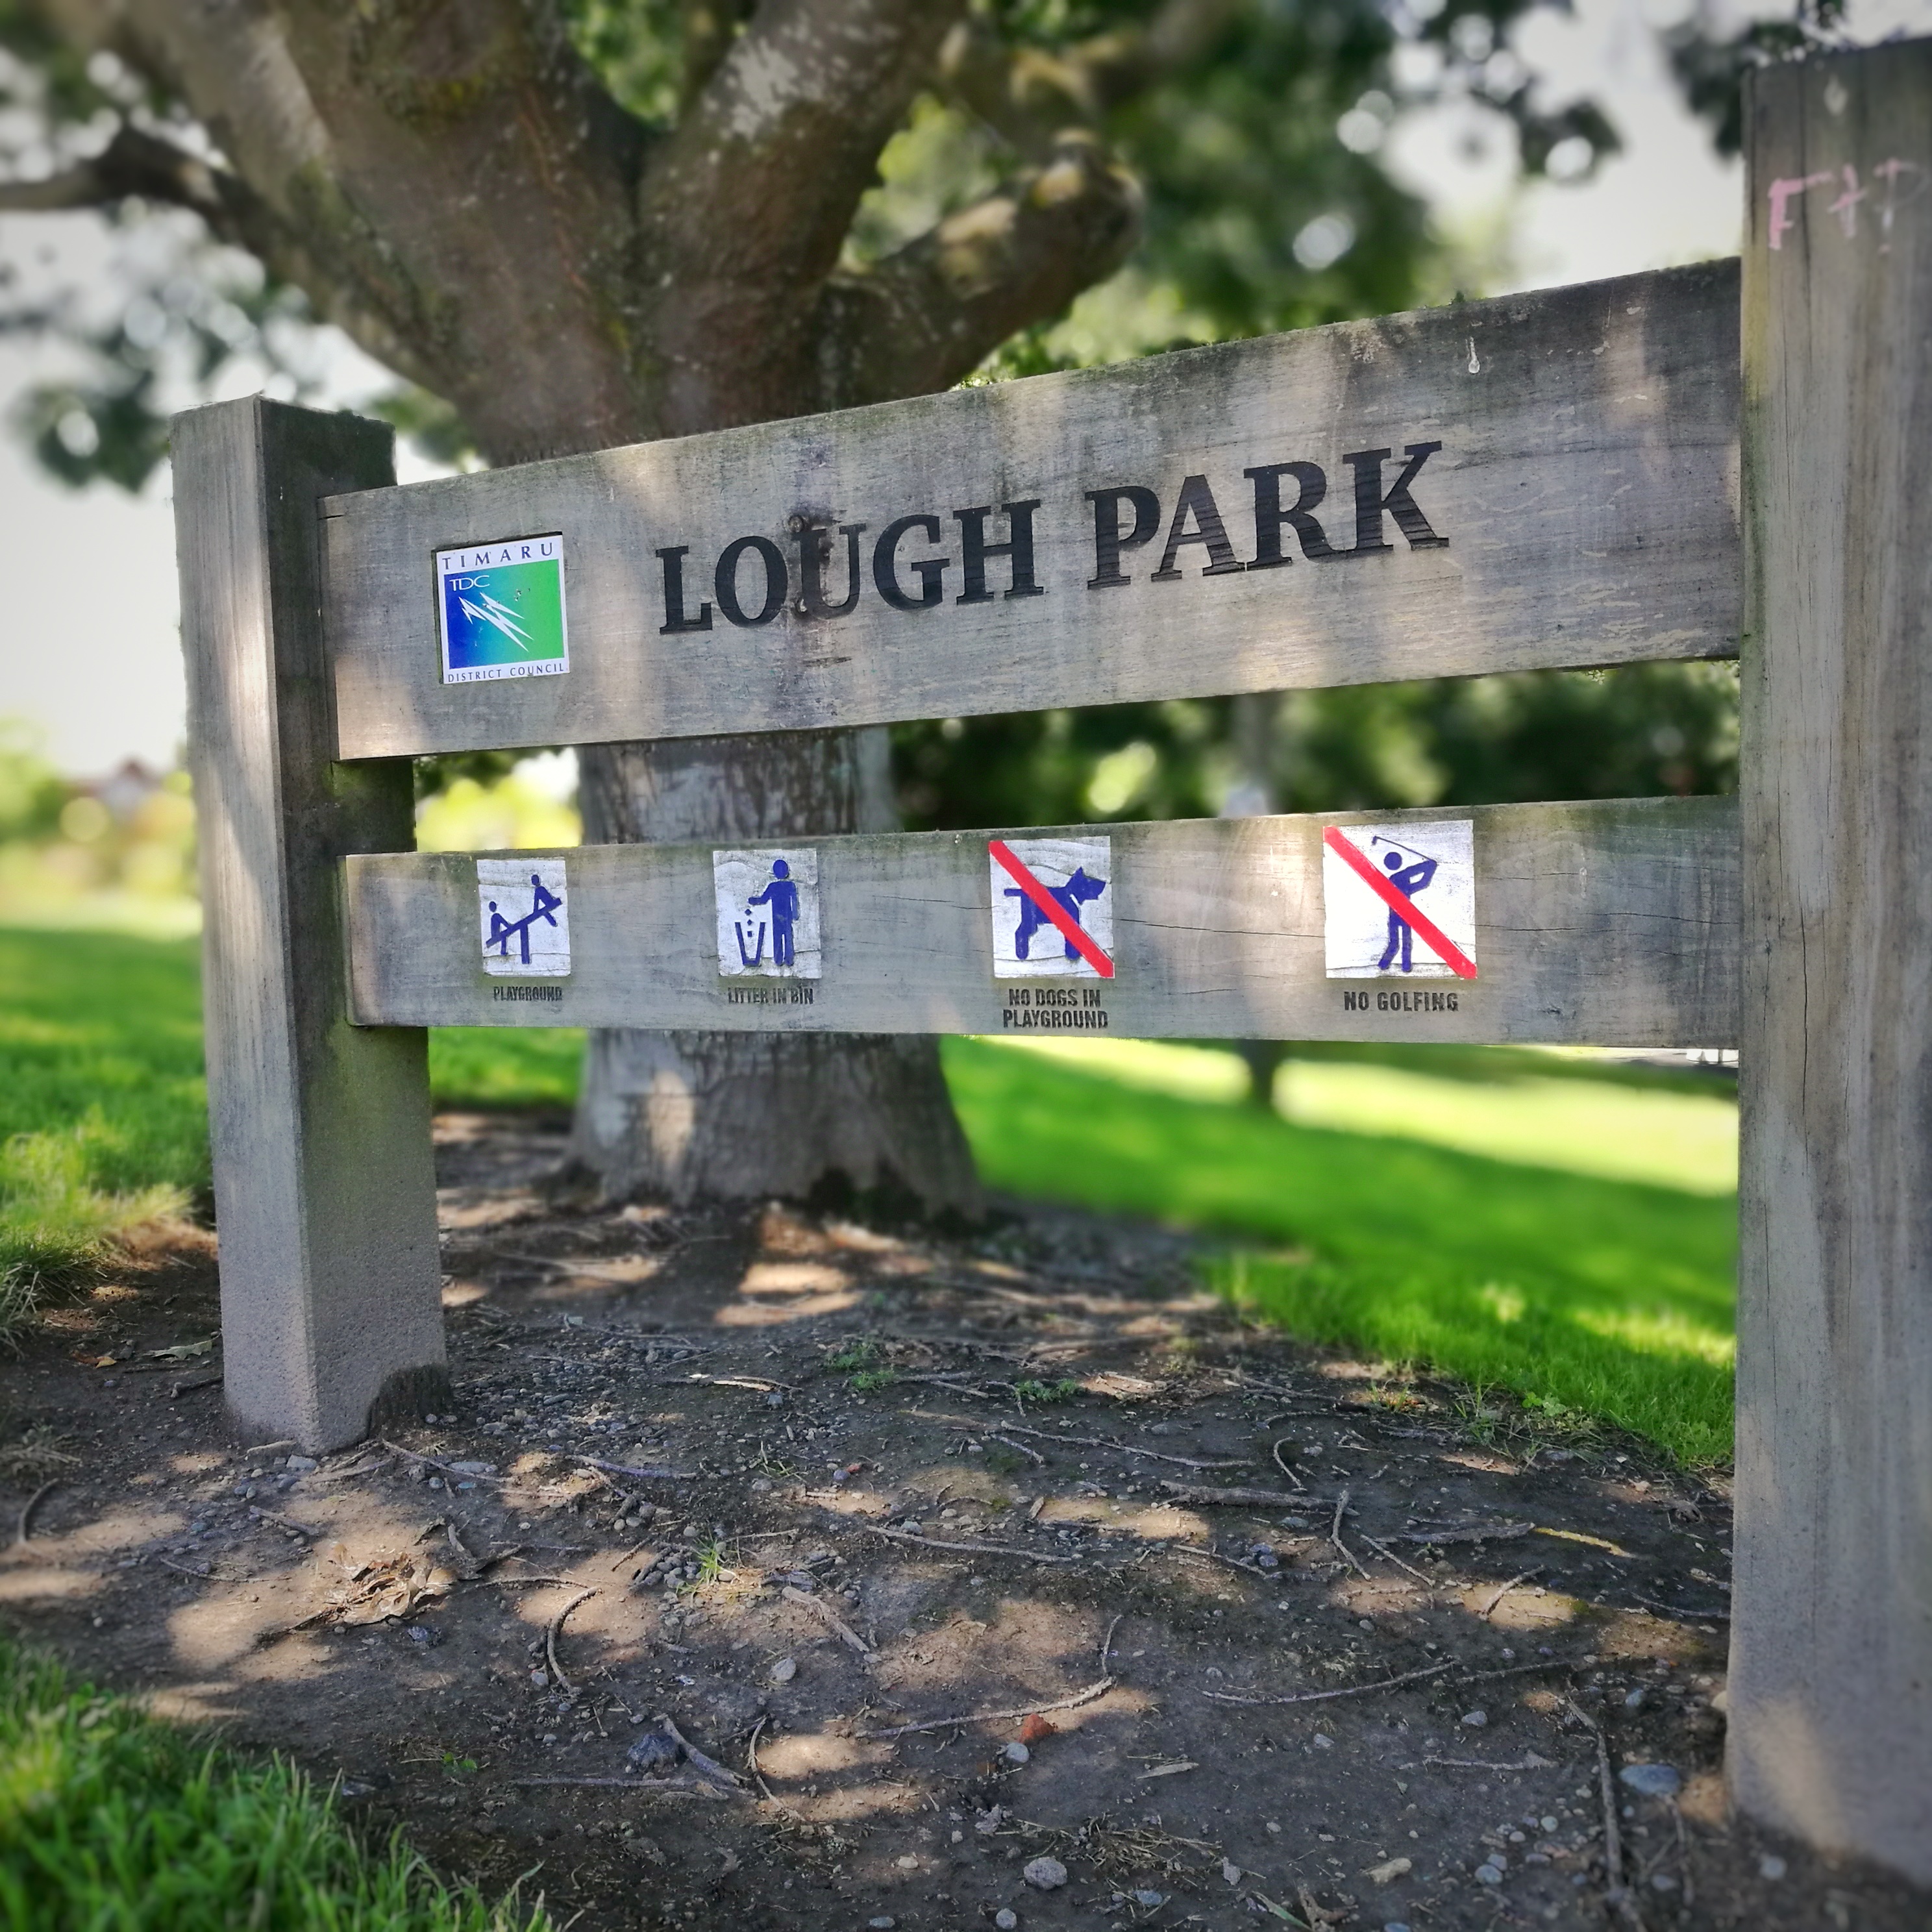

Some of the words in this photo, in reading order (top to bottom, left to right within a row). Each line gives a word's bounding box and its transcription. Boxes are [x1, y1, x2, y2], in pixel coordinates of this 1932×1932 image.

[654, 499, 1044, 635] LOUGH
[1084, 440, 1450, 590] PARK
[442, 542, 553, 570] TIMARU
[449, 575, 490, 591] TDC
[448, 669, 502, 682] DISTRICT
[510, 662, 564, 676] COUNCIL
[493, 986, 563, 1002] PLAYGROUND
[728, 987, 769, 1004] LITTER
[773, 987, 787, 1004] IN
[790, 987, 813, 1004] BIN
[1008, 989, 1031, 1007] NO
[1035, 989, 1078, 1007] DOGS
[1084, 989, 1102, 1008] IN
[1343, 991, 1369, 1011] NO
[1377, 991, 1459, 1011] GOLFING
[1003, 1009, 1109, 1029] PLAYGROUND
